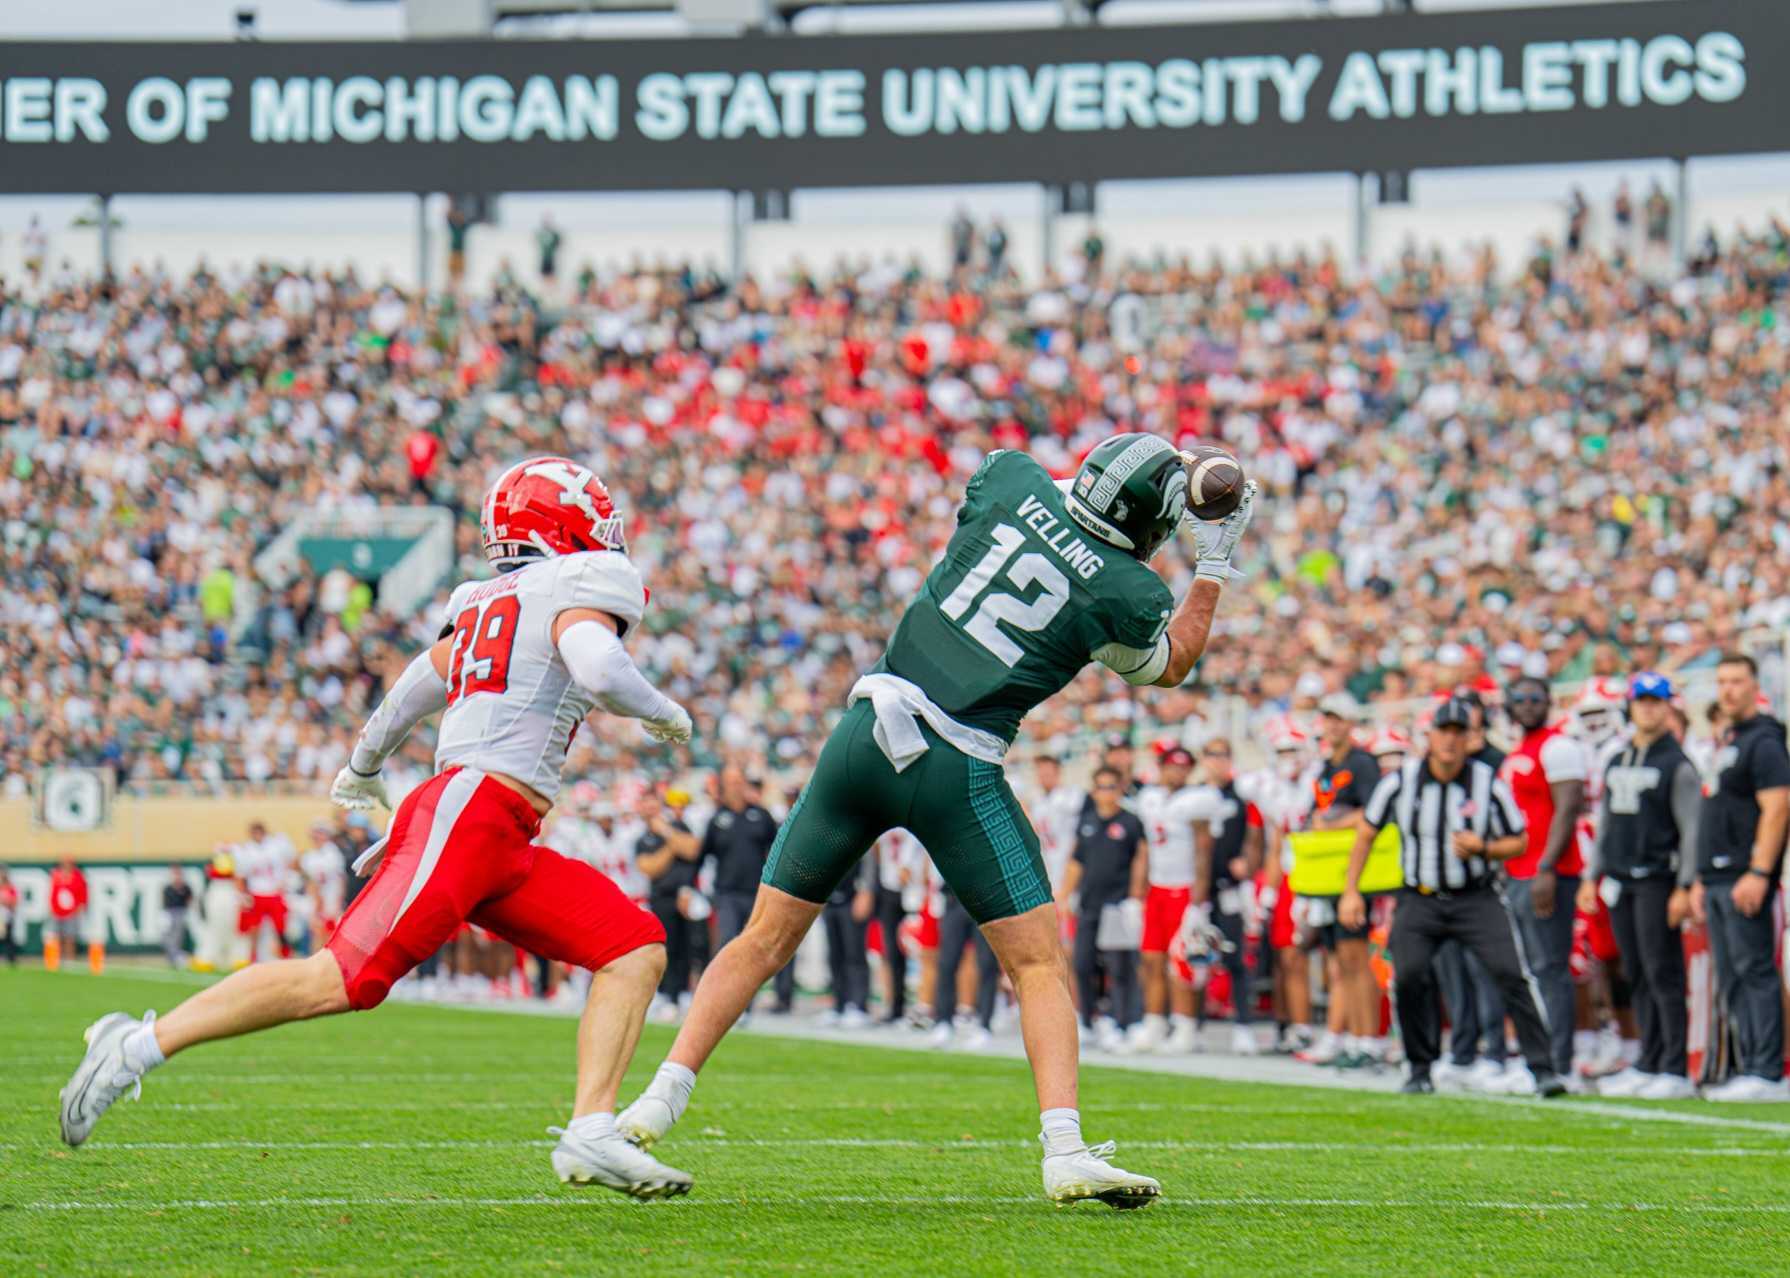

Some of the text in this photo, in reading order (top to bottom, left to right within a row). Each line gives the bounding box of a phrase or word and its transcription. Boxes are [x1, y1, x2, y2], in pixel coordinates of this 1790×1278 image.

[0, 32, 1746, 143] ER OF MICHIGAN STATE UNIVERSITY ATHLETICS
[1016, 495, 1105, 580] VELLING
[1070, 505, 1111, 538] SPARTANS
[940, 522, 1070, 669] 12
